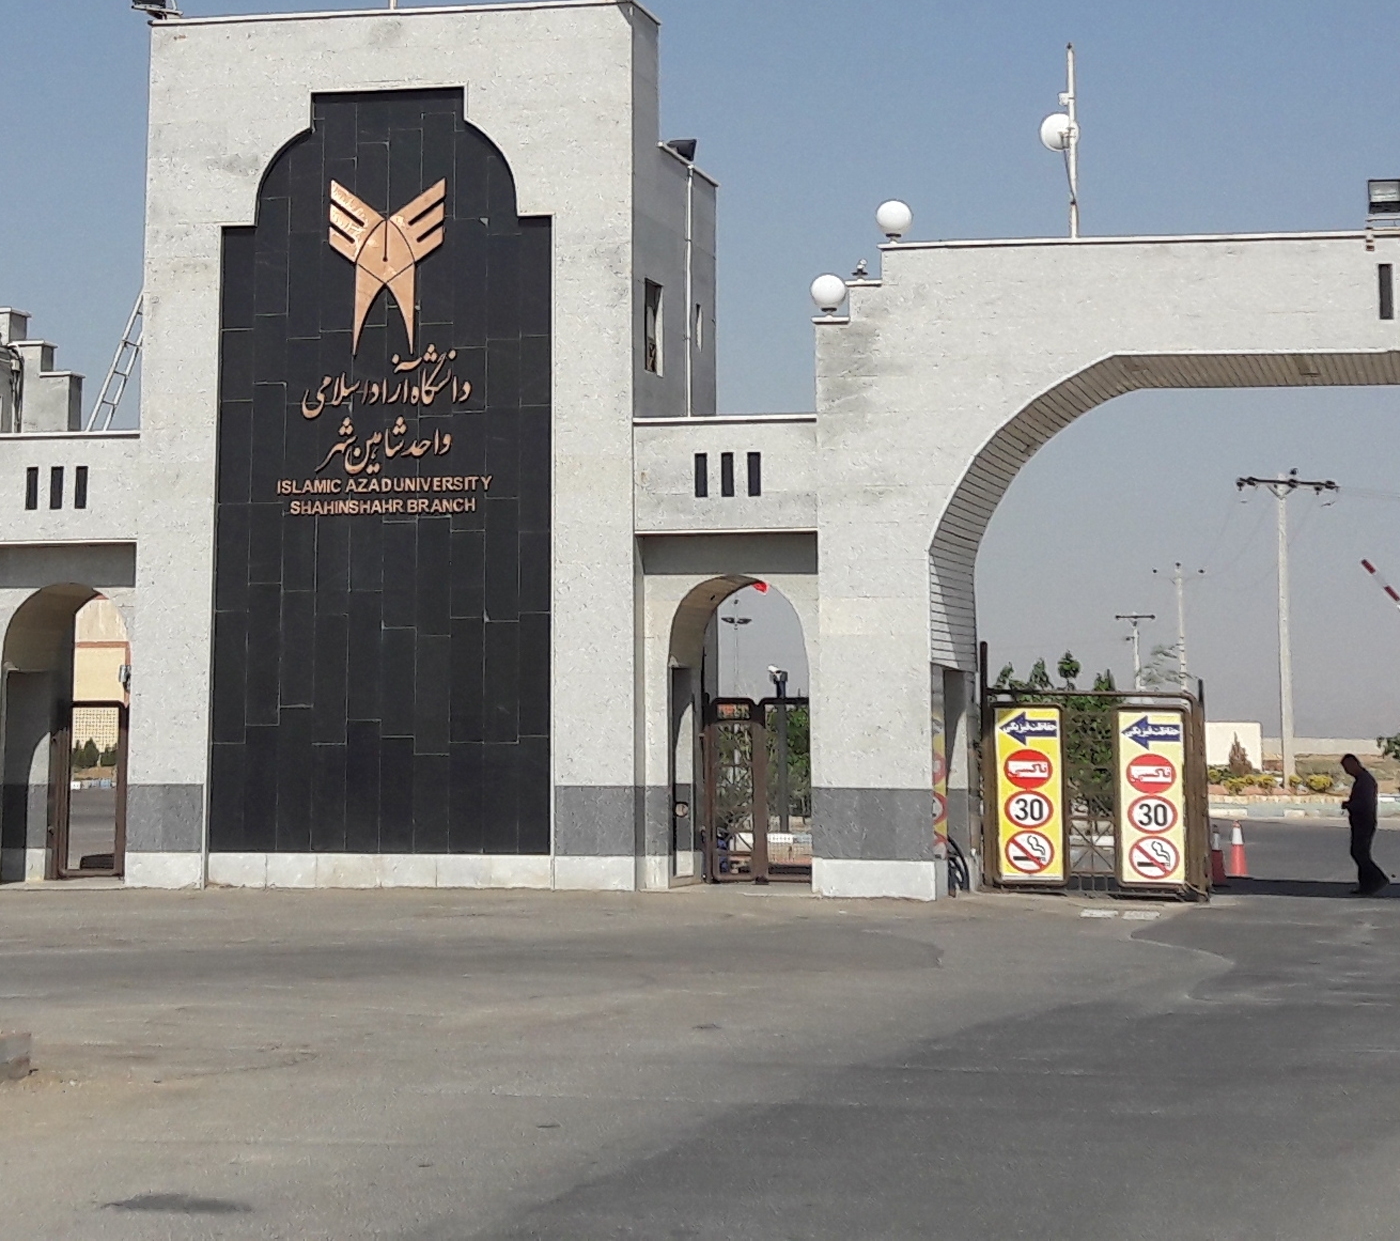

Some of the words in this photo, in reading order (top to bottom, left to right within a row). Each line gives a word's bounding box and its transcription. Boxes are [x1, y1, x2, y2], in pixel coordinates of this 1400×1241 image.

[411, 343, 472, 406] دانشگاه
[301, 371, 369, 419] اسلامی
[405, 427, 453, 457] واحد
[276, 478, 341, 495] ISLAMIC
[290, 499, 404, 515] SHAHINSHAHR
[407, 497, 476, 513] BRANCH
[1014, 798, 1044, 822] 30
[1137, 803, 1168, 827] 30
